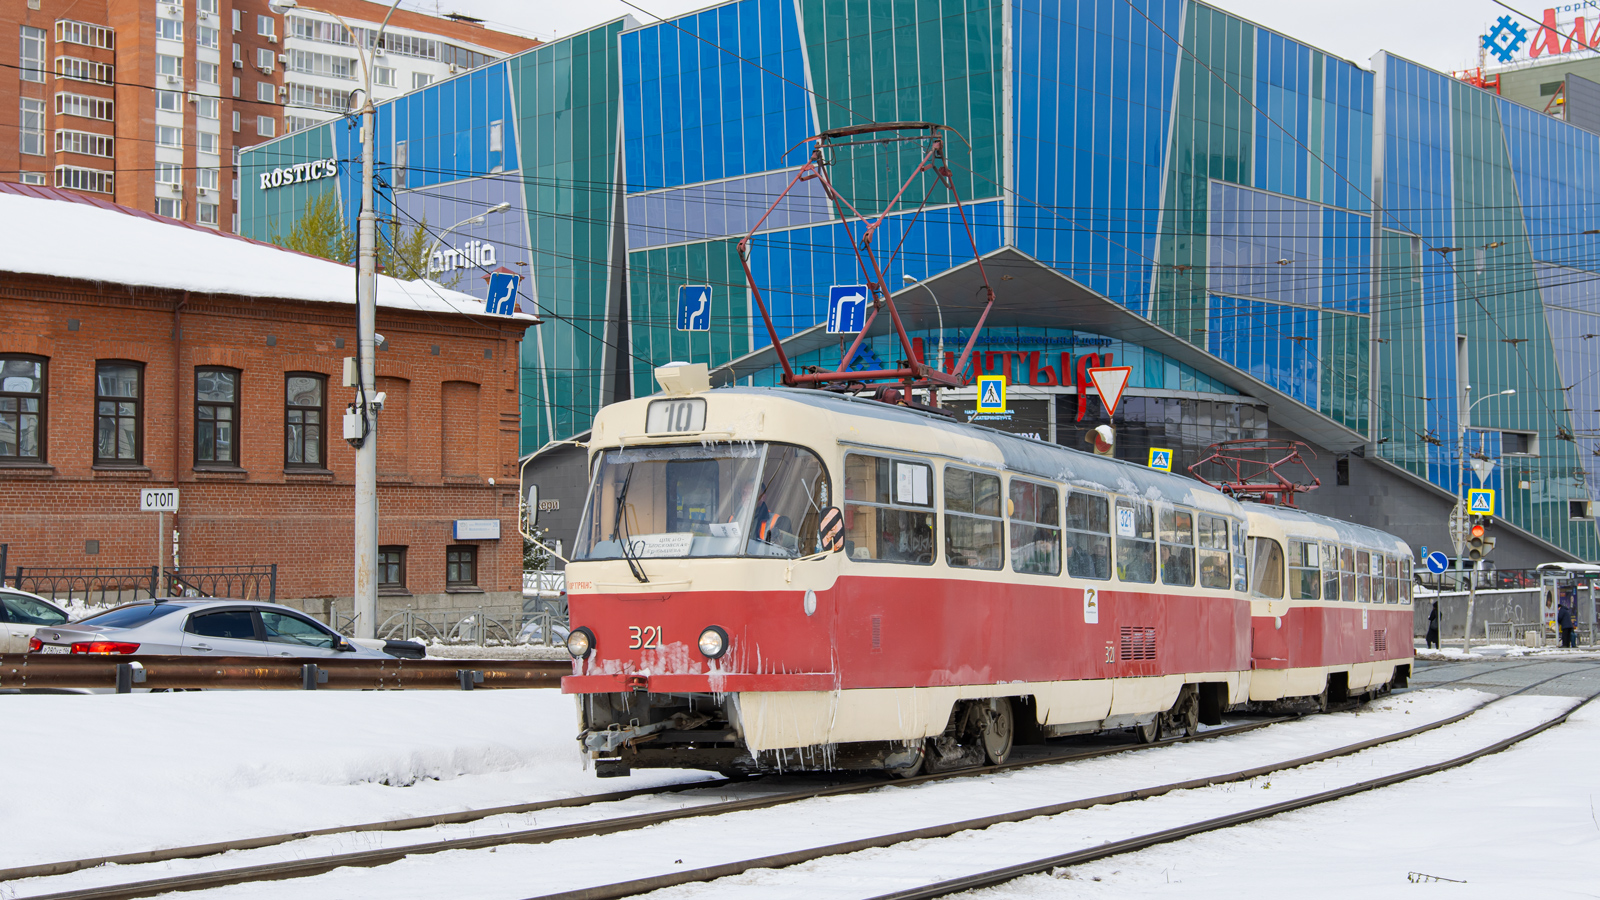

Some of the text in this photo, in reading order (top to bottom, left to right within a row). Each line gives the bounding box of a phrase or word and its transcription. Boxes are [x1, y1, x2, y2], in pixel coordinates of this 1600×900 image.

[260, 158, 337, 189] ROSTIC'S
[665, 402, 692, 432] 10
[146, 492, 174, 507] СТОП
[1120, 510, 1132, 528] 321
[1086, 588, 1096, 608] 2
[628, 625, 663, 649] 321
[1105, 646, 1115, 664] 321
